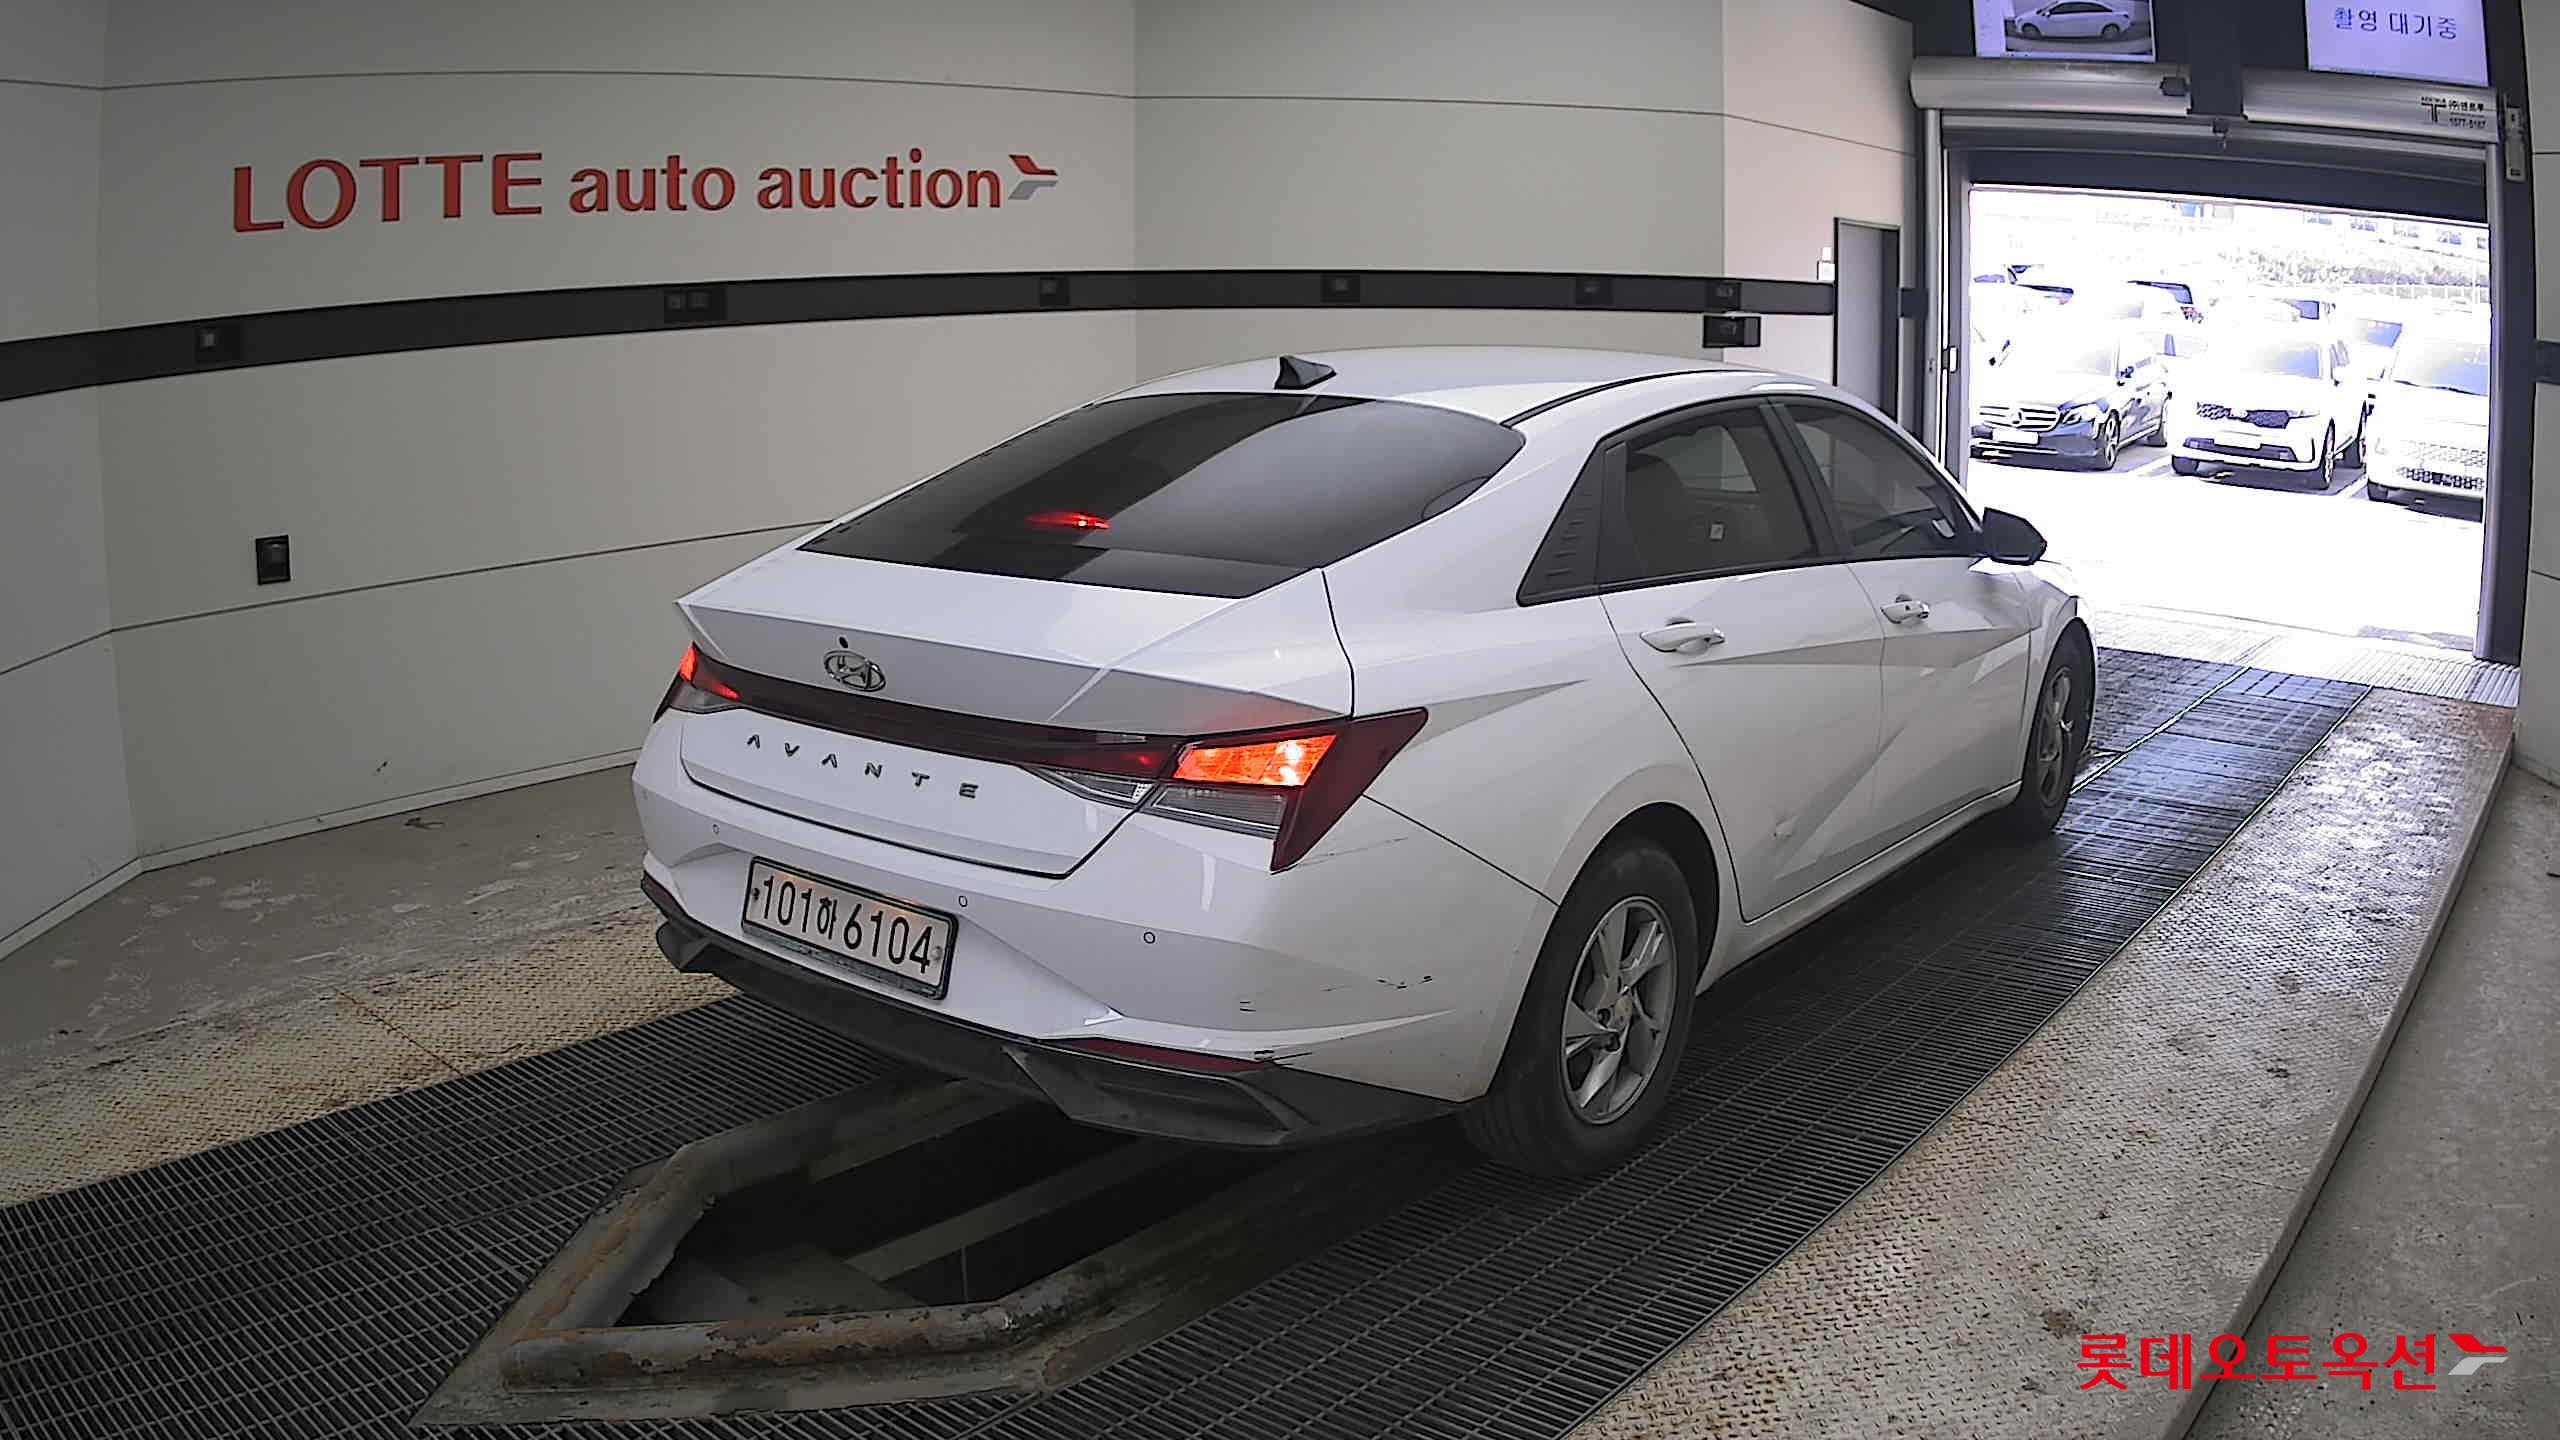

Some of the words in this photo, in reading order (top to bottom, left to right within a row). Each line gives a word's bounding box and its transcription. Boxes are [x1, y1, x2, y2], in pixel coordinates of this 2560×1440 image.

[2335, 7, 2377, 32] 촬영
[2389, 12, 2457, 40] 대기중
[233, 153, 543, 233] LOTTE
[568, 155, 737, 214] auto
[757, 147, 1002, 210] auction
[747, 734, 979, 799] AVANTE
